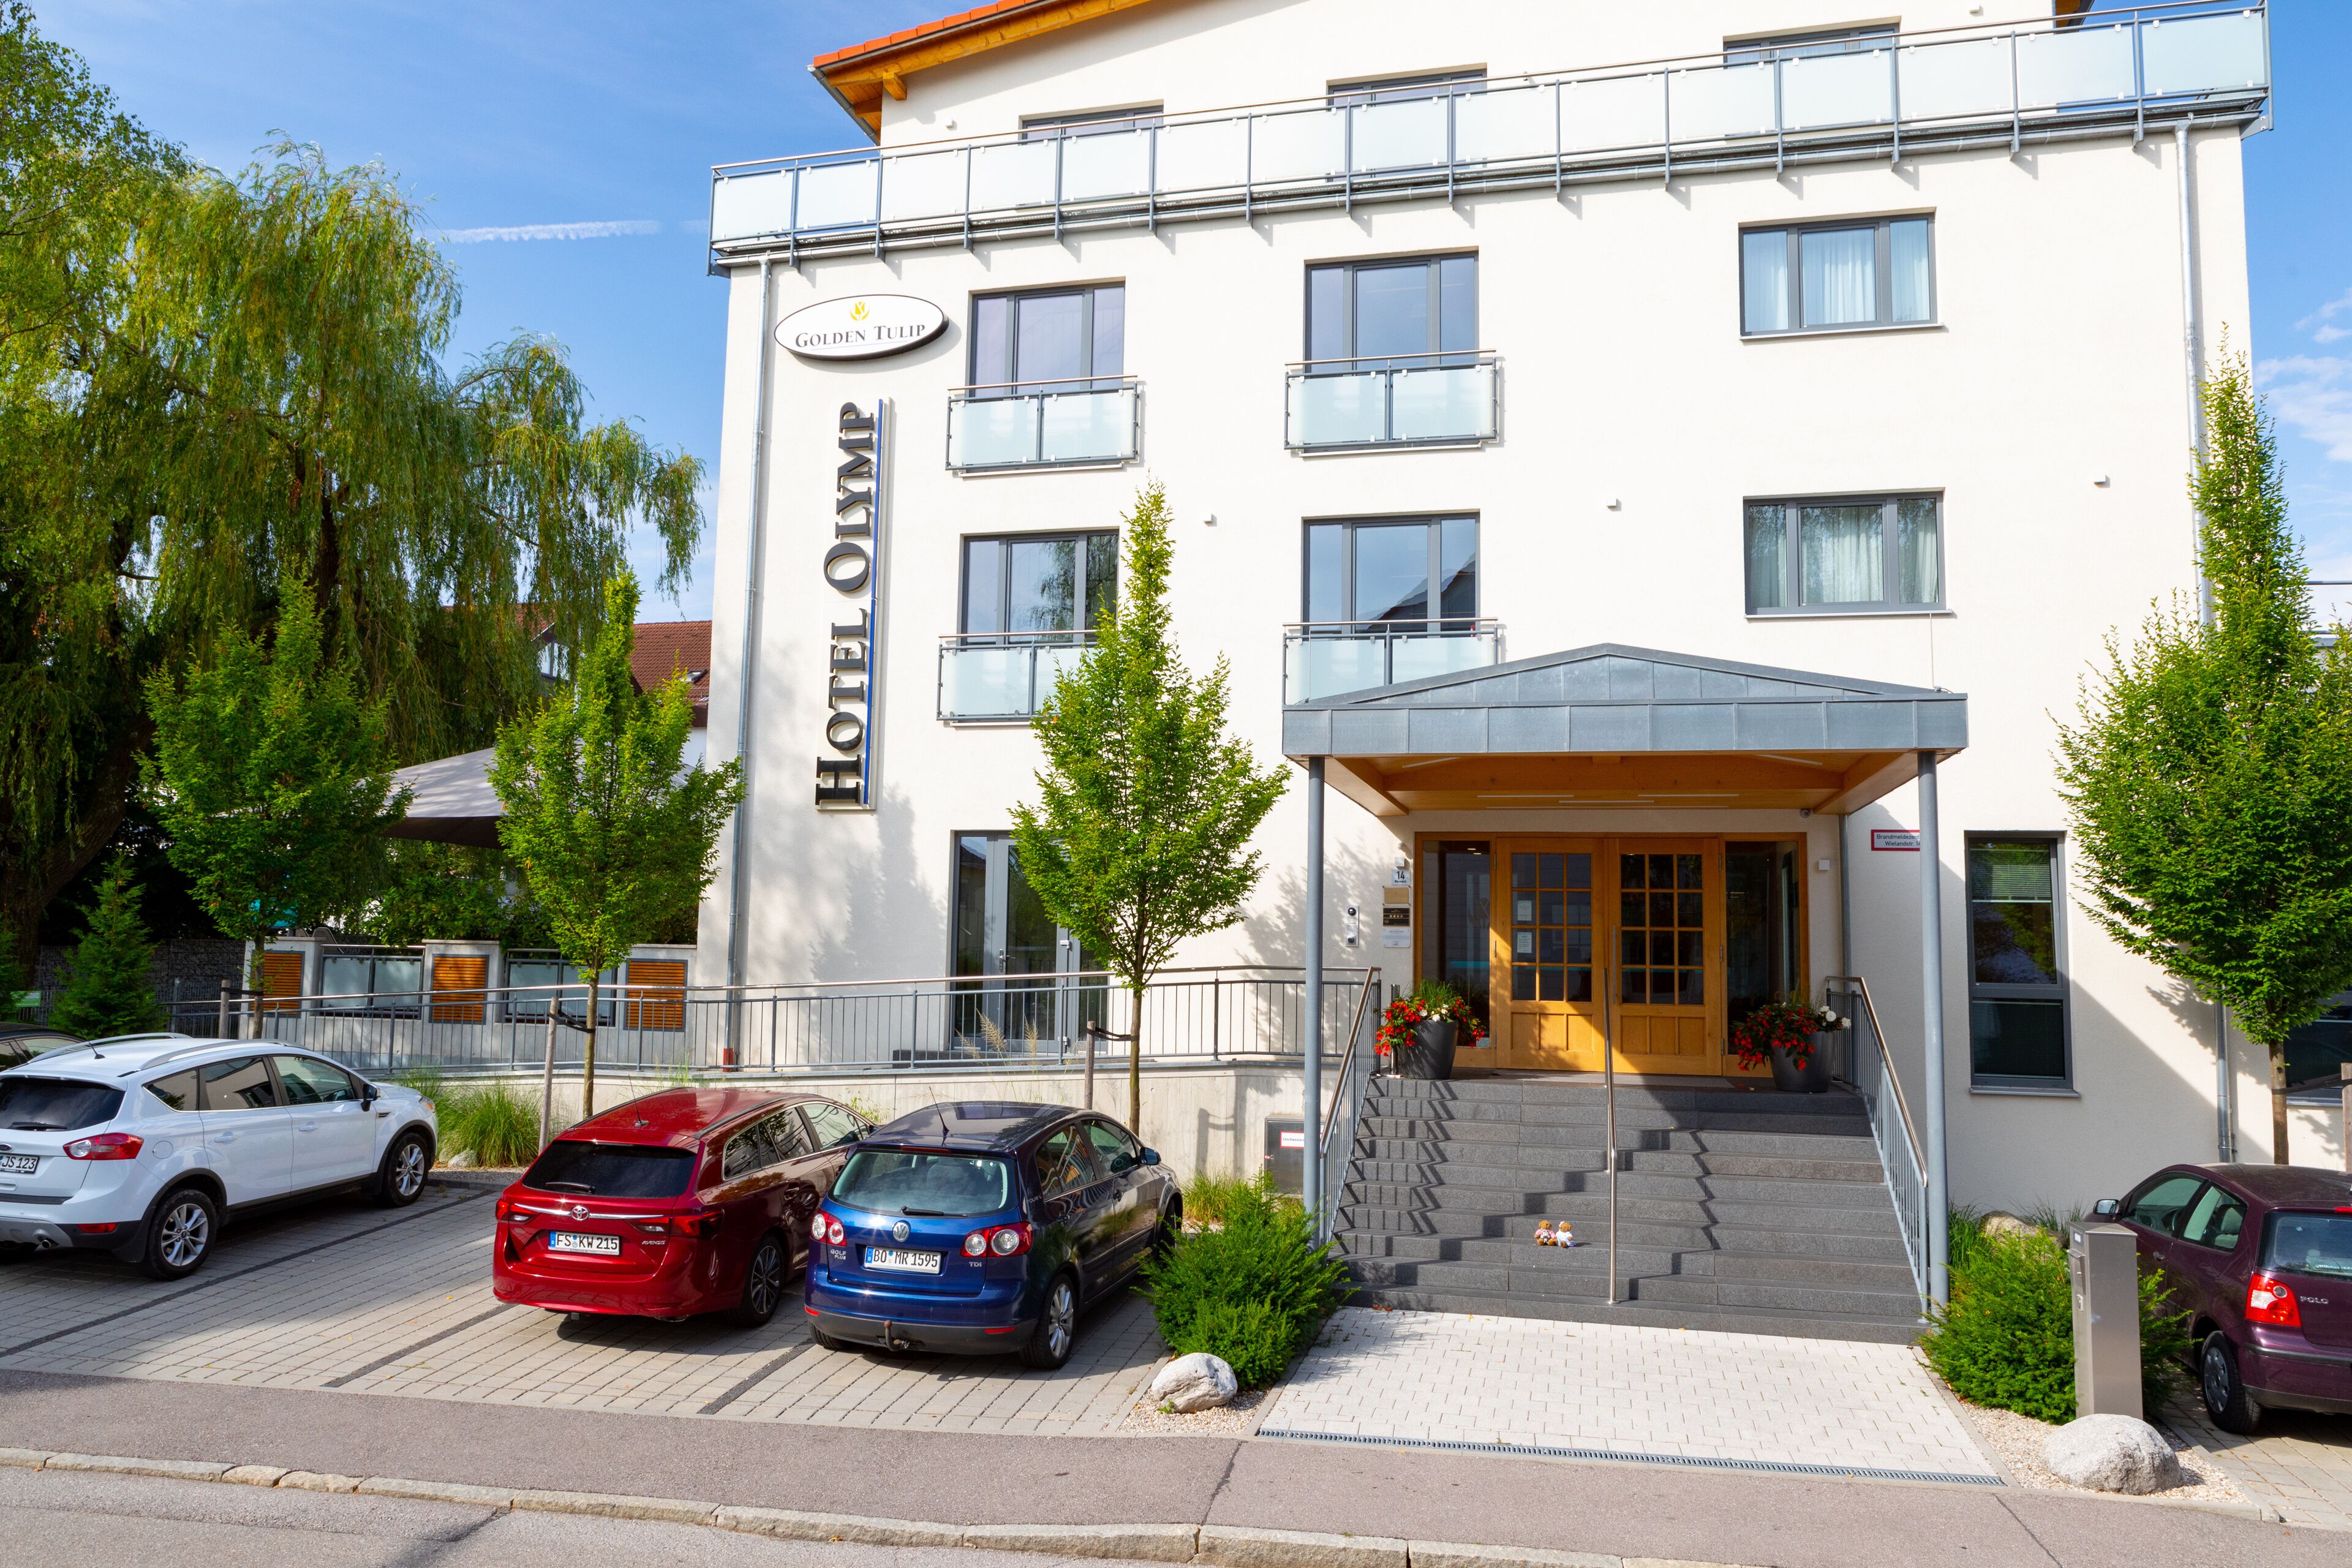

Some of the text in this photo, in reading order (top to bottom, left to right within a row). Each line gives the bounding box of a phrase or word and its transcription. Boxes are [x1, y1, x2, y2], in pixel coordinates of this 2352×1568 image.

[796, 324, 925, 348] GOLDEN TULIP
[815, 402, 875, 805] HOTEL OLYMP
[1396, 871, 1405, 880] 14
[2, 1156, 36, 1169] JS 123
[596, 1237, 618, 1250] 215
[911, 1253, 938, 1267] 1595
